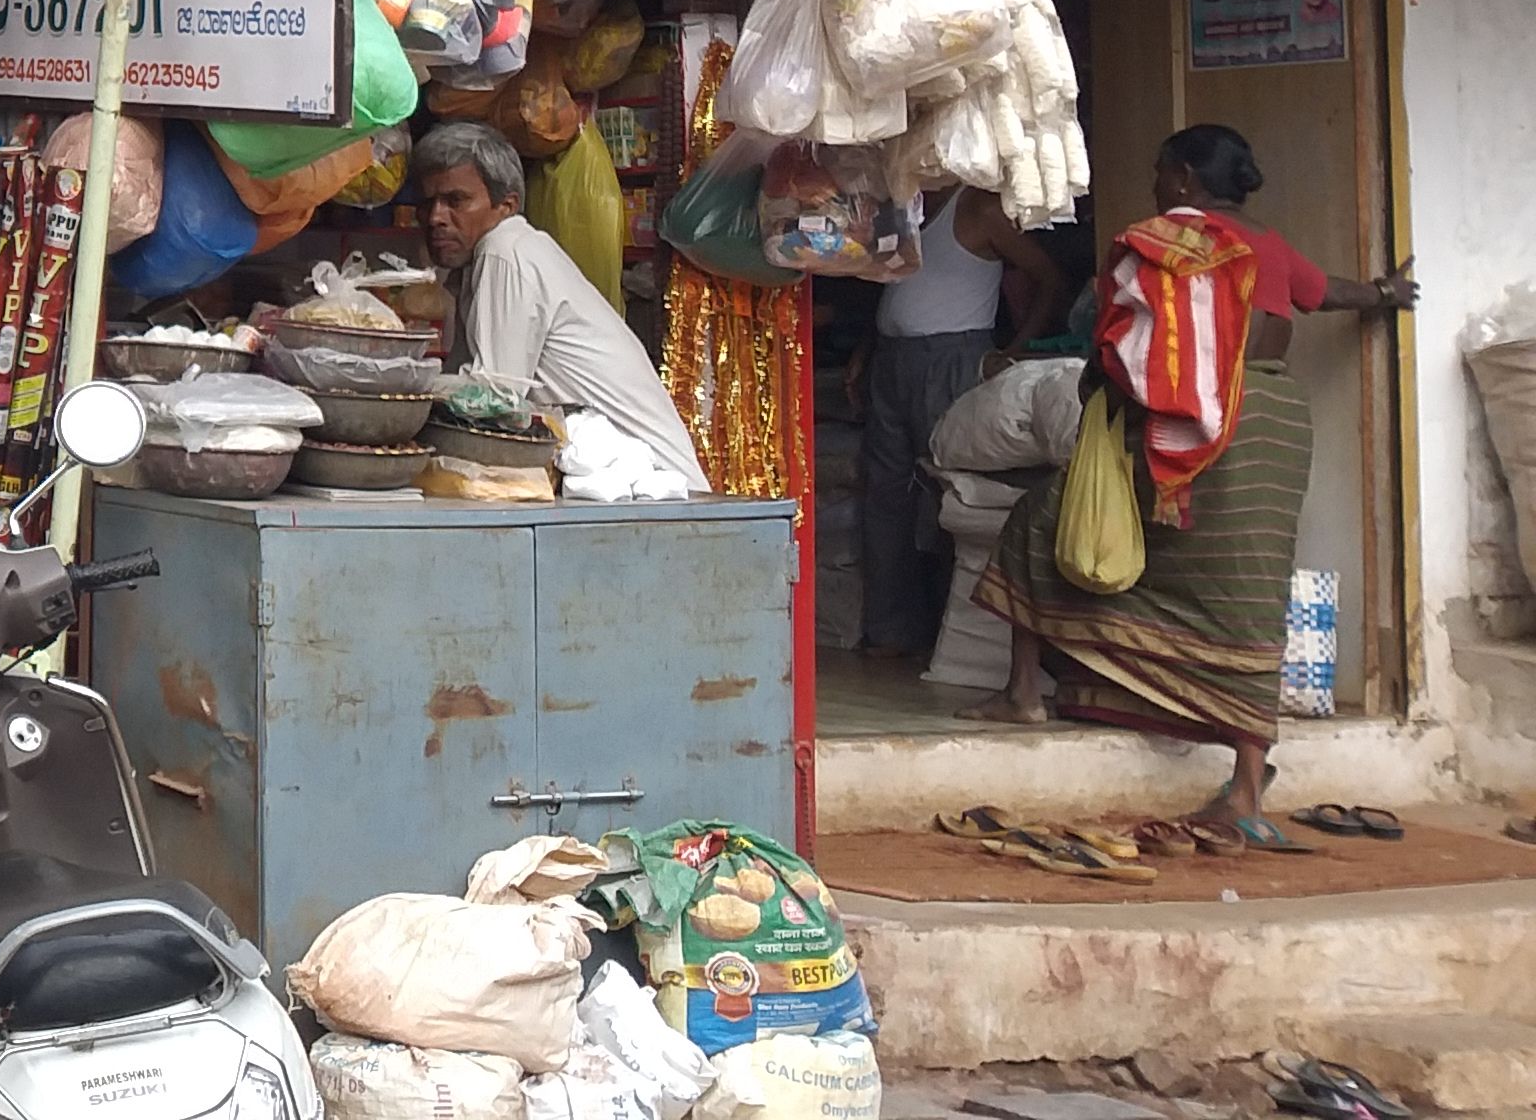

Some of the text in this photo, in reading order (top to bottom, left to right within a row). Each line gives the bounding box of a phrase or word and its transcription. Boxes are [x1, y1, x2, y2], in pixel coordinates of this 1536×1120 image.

[121, 61, 221, 91] 62235945
[81, 1067, 163, 1092] PARAMESHWARI
[765, 1060, 842, 1091] CALCIUM
[88, 1083, 168, 1106] SUZUKI
